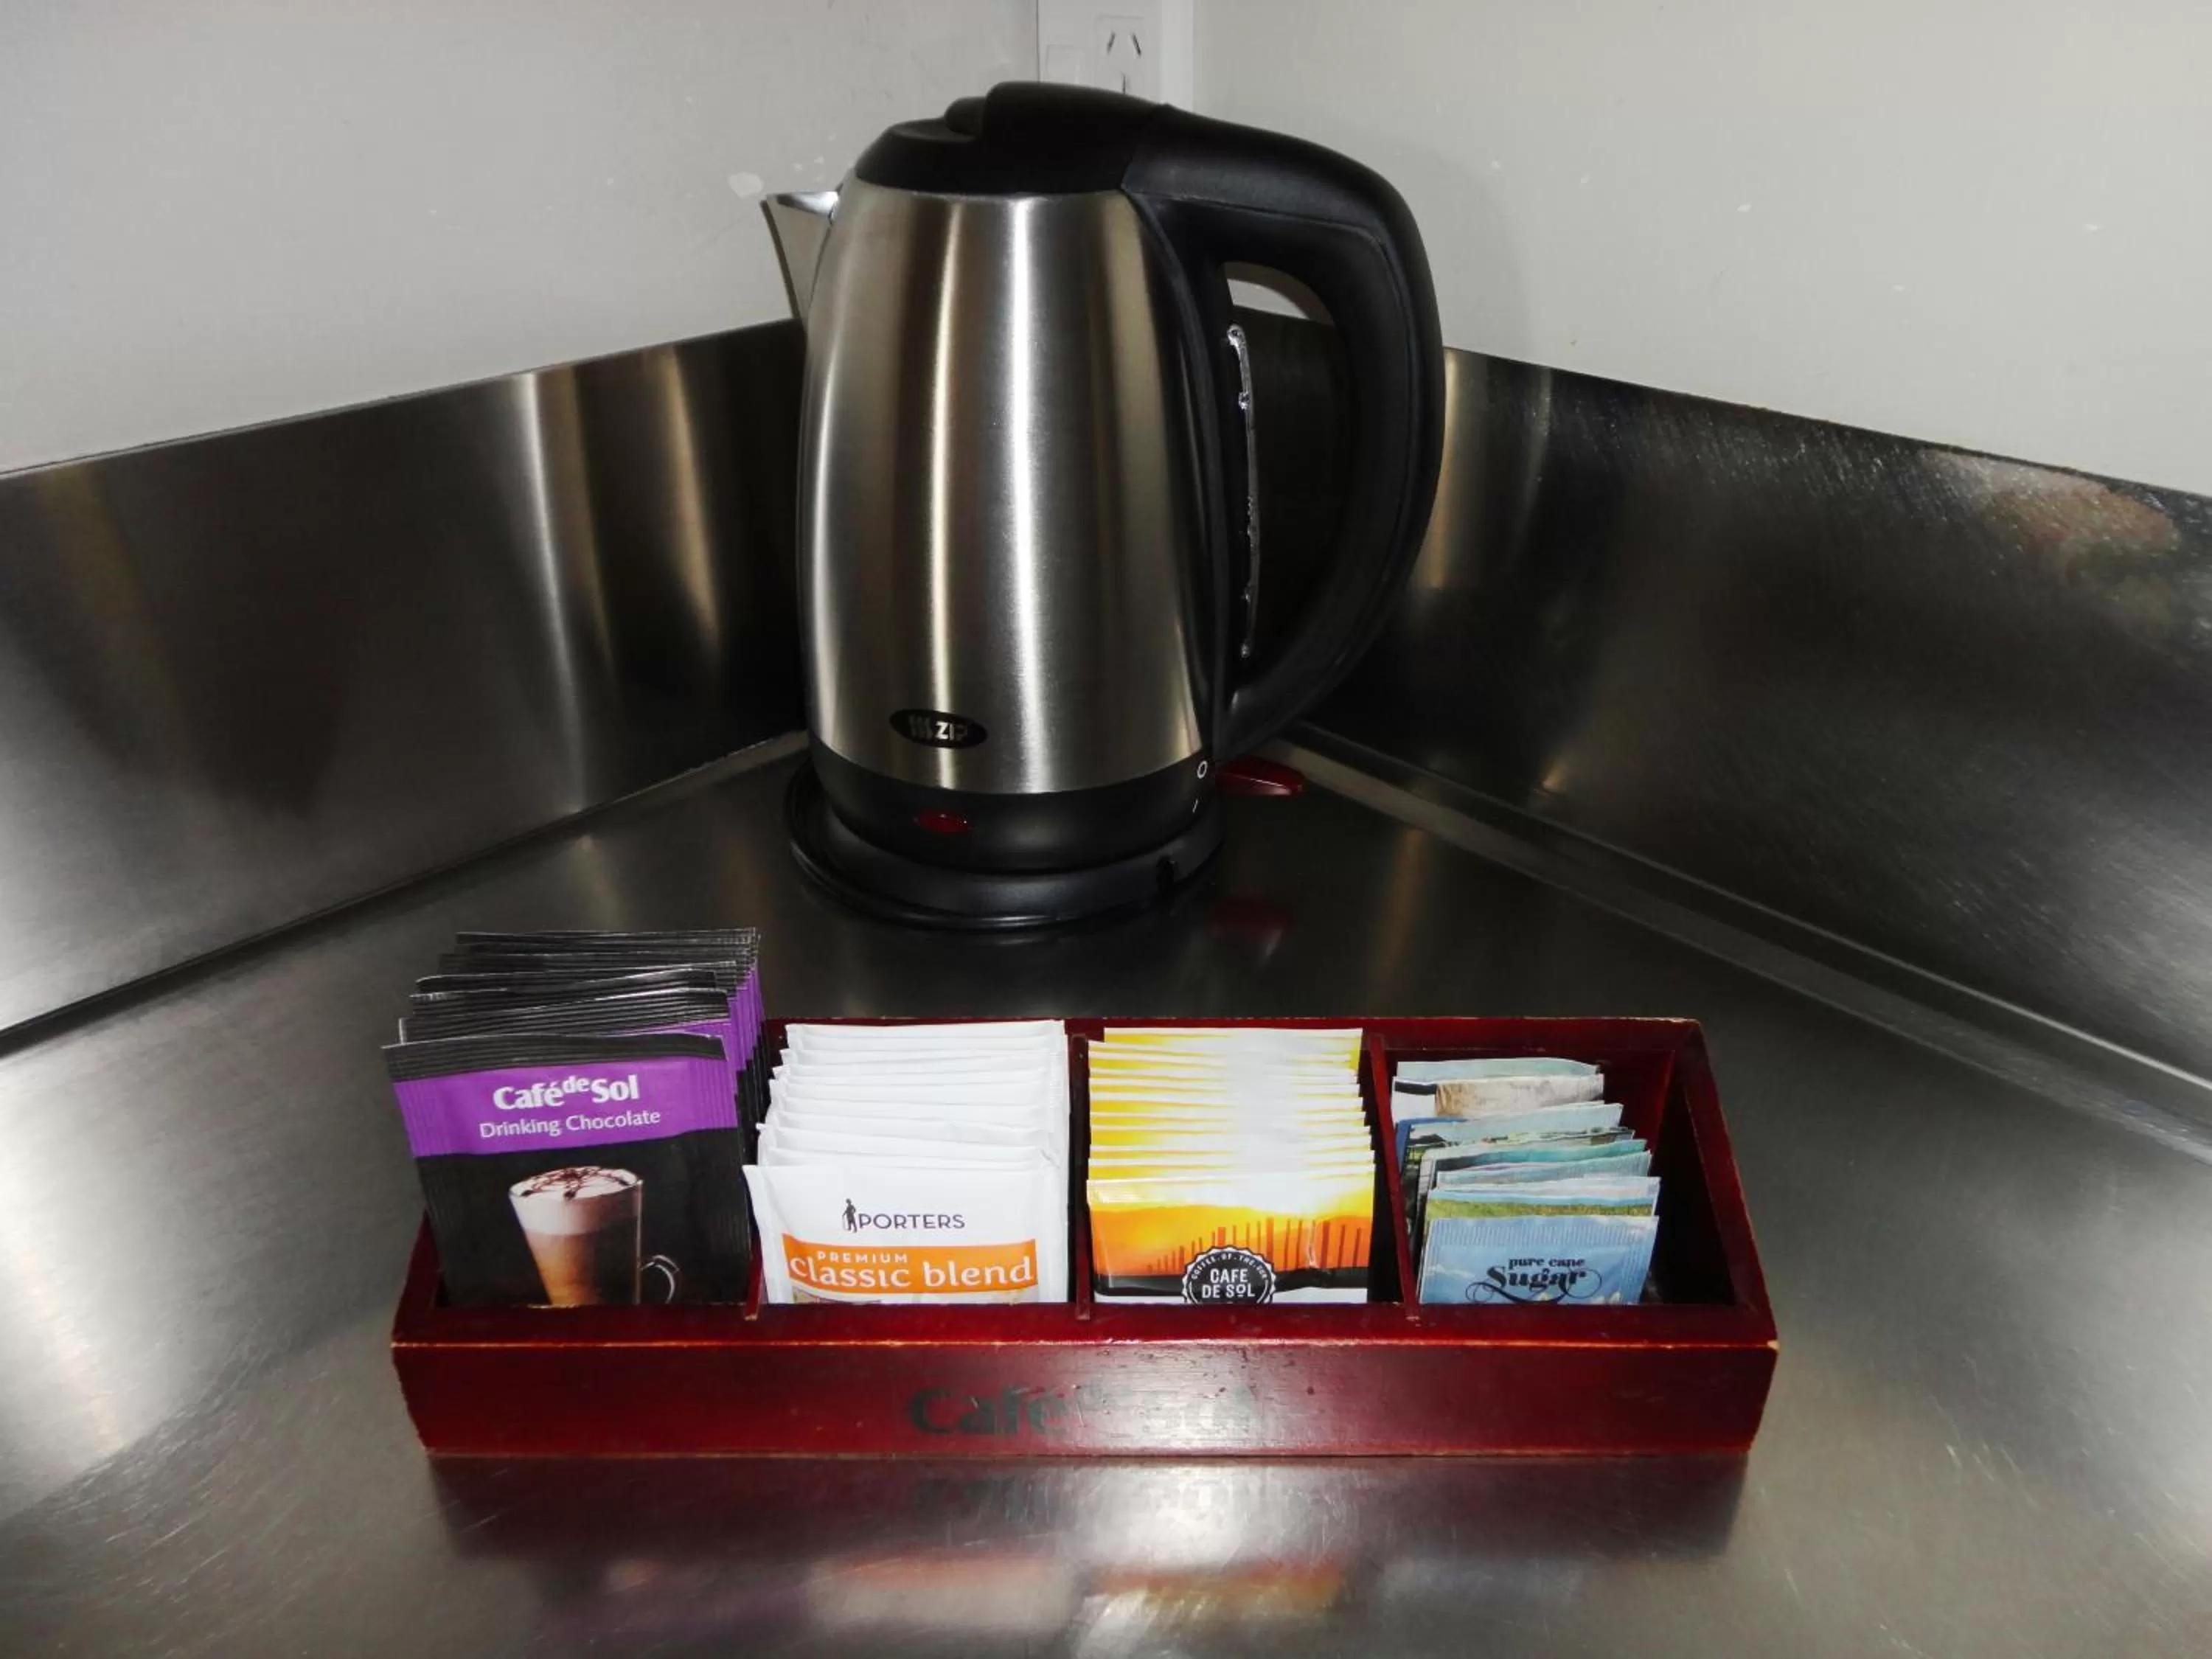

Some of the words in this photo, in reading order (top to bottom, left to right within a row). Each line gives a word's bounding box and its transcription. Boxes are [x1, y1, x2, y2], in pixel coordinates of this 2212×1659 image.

[493, 1081, 565, 1110] Café
[562, 1075, 590, 1093] de
[591, 1074, 640, 1104] Sol
[479, 1118, 563, 1138] Drinking
[566, 1110, 661, 1131] Chocolate
[858, 1212, 966, 1230] PORTERS
[817, 1250, 908, 1263] PREMIUM
[1508, 1258, 1545, 1270] pure
[1548, 1258, 1585, 1267] cane
[923, 1256, 1033, 1288] blend
[1209, 1267, 1249, 1284] CAFE
[1201, 1284, 1222, 1299] DE
[1225, 1283, 1256, 1298] SOL
[1478, 1264, 1591, 1300] Sugar
